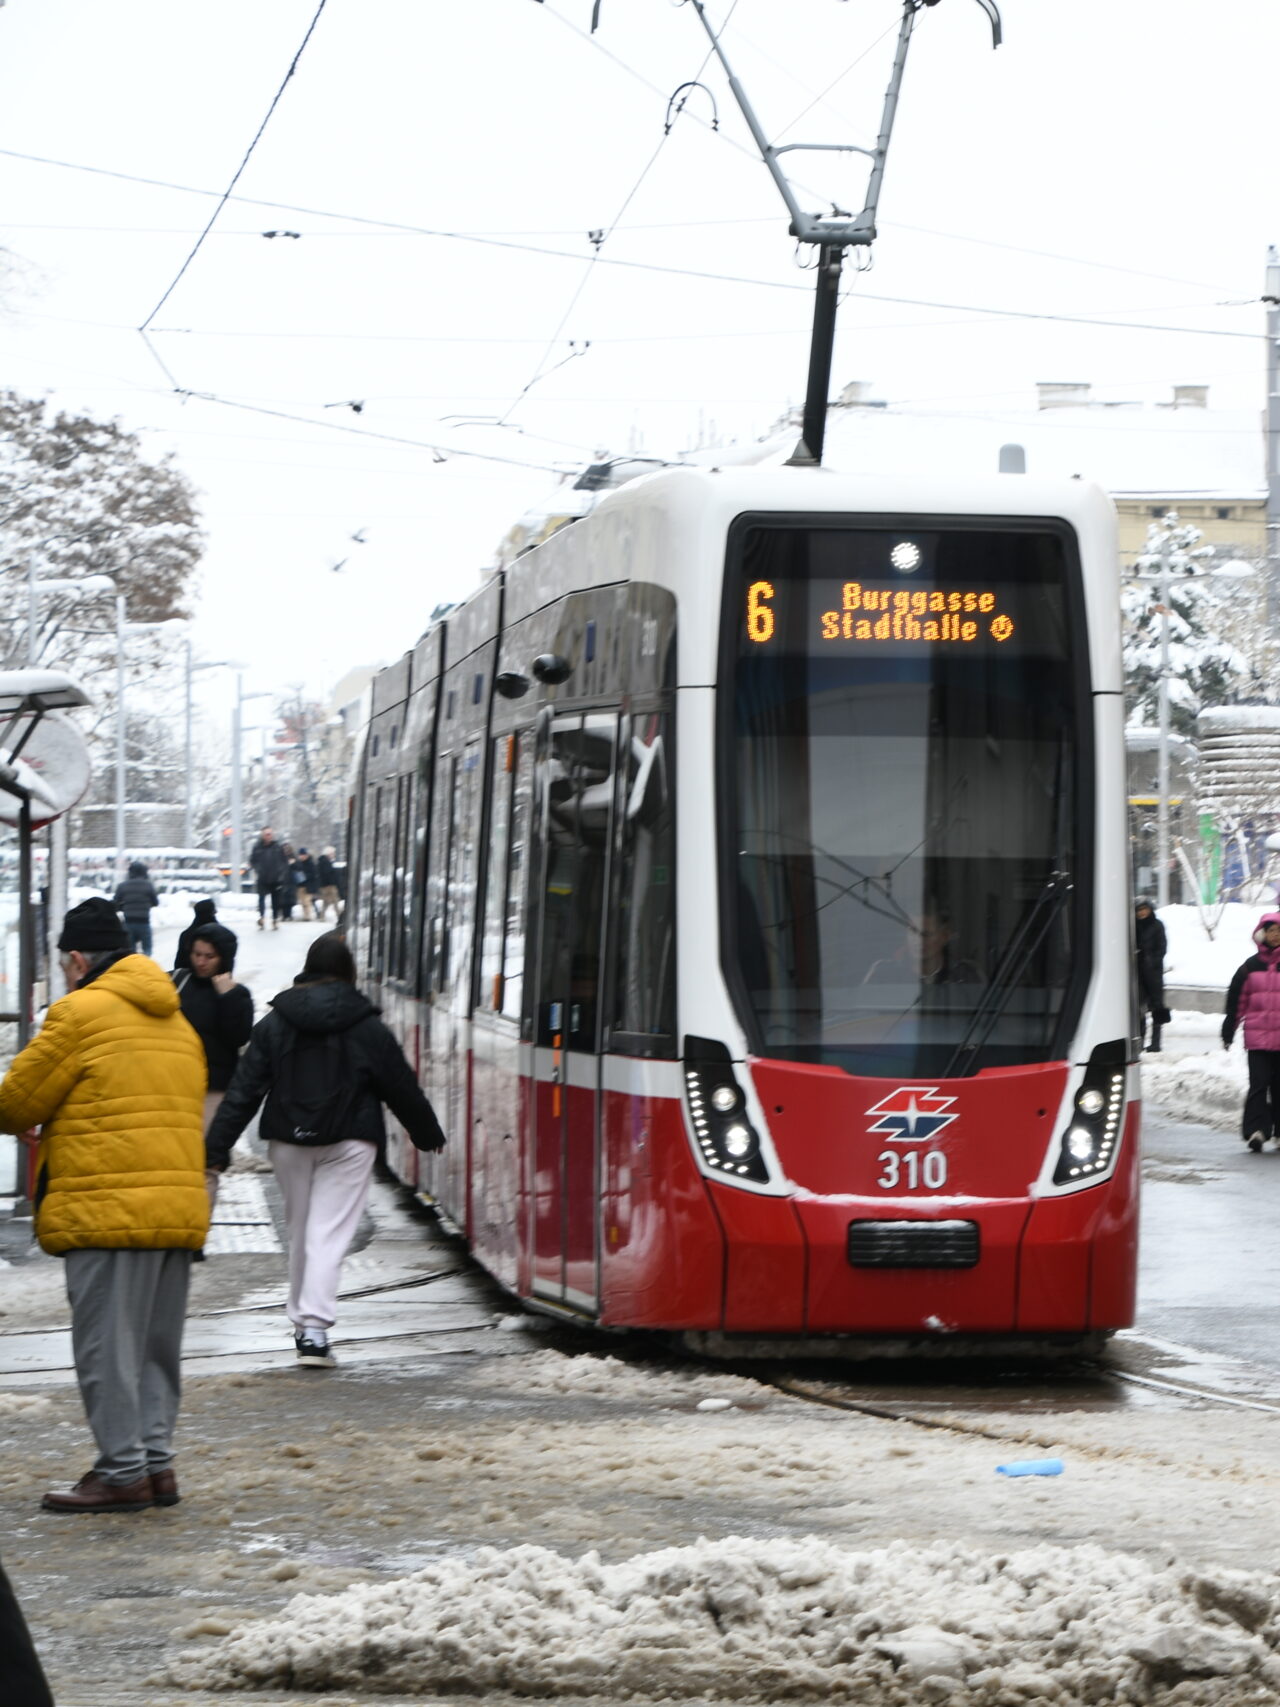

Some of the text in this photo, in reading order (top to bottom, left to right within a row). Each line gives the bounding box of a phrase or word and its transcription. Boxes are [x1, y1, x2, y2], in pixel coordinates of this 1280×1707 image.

[747, 581, 775, 642] 6
[842, 582, 996, 616] Burggasse
[820, 611, 978, 642] Stadthalle
[876, 1150, 948, 1190] 310
